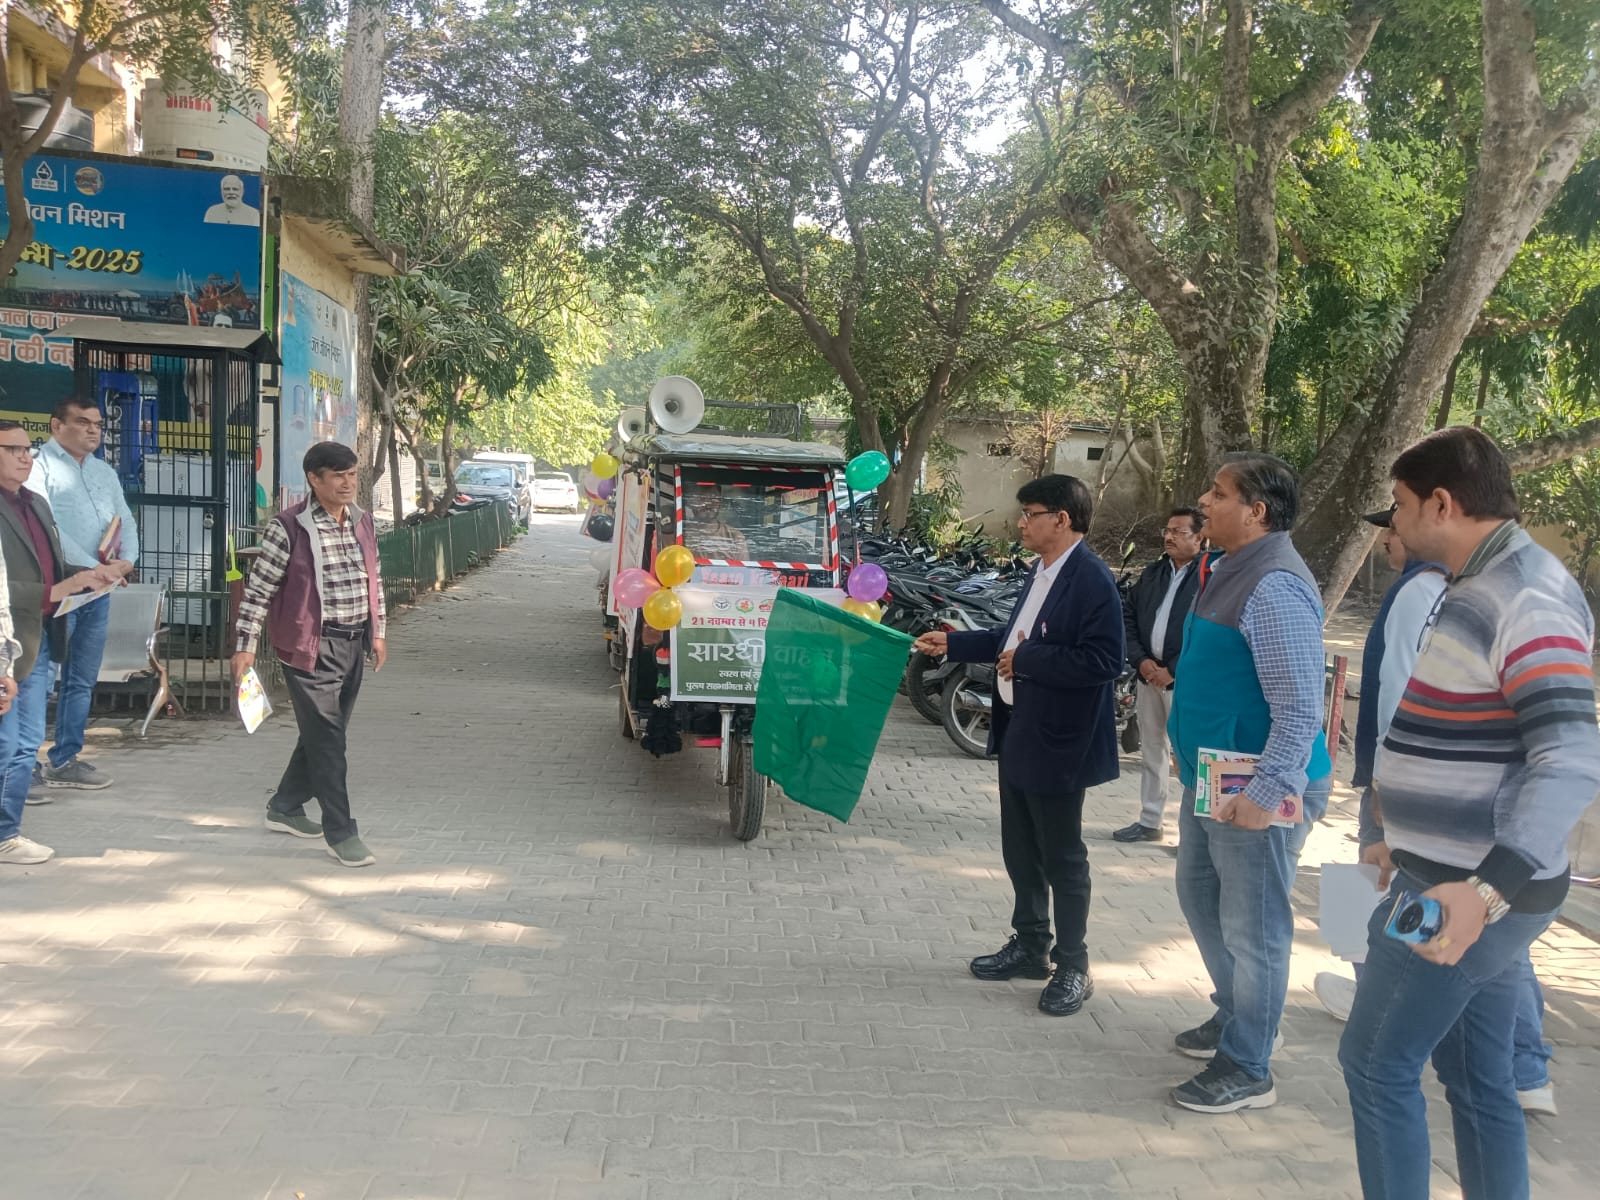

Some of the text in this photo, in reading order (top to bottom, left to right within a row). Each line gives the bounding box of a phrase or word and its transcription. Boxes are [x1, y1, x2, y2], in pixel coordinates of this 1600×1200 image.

[67, 202, 126, 230] मिशन
[30, 311, 55, 329] का
[14, 334, 45, 364] की
[691, 616, 705, 626] 21
